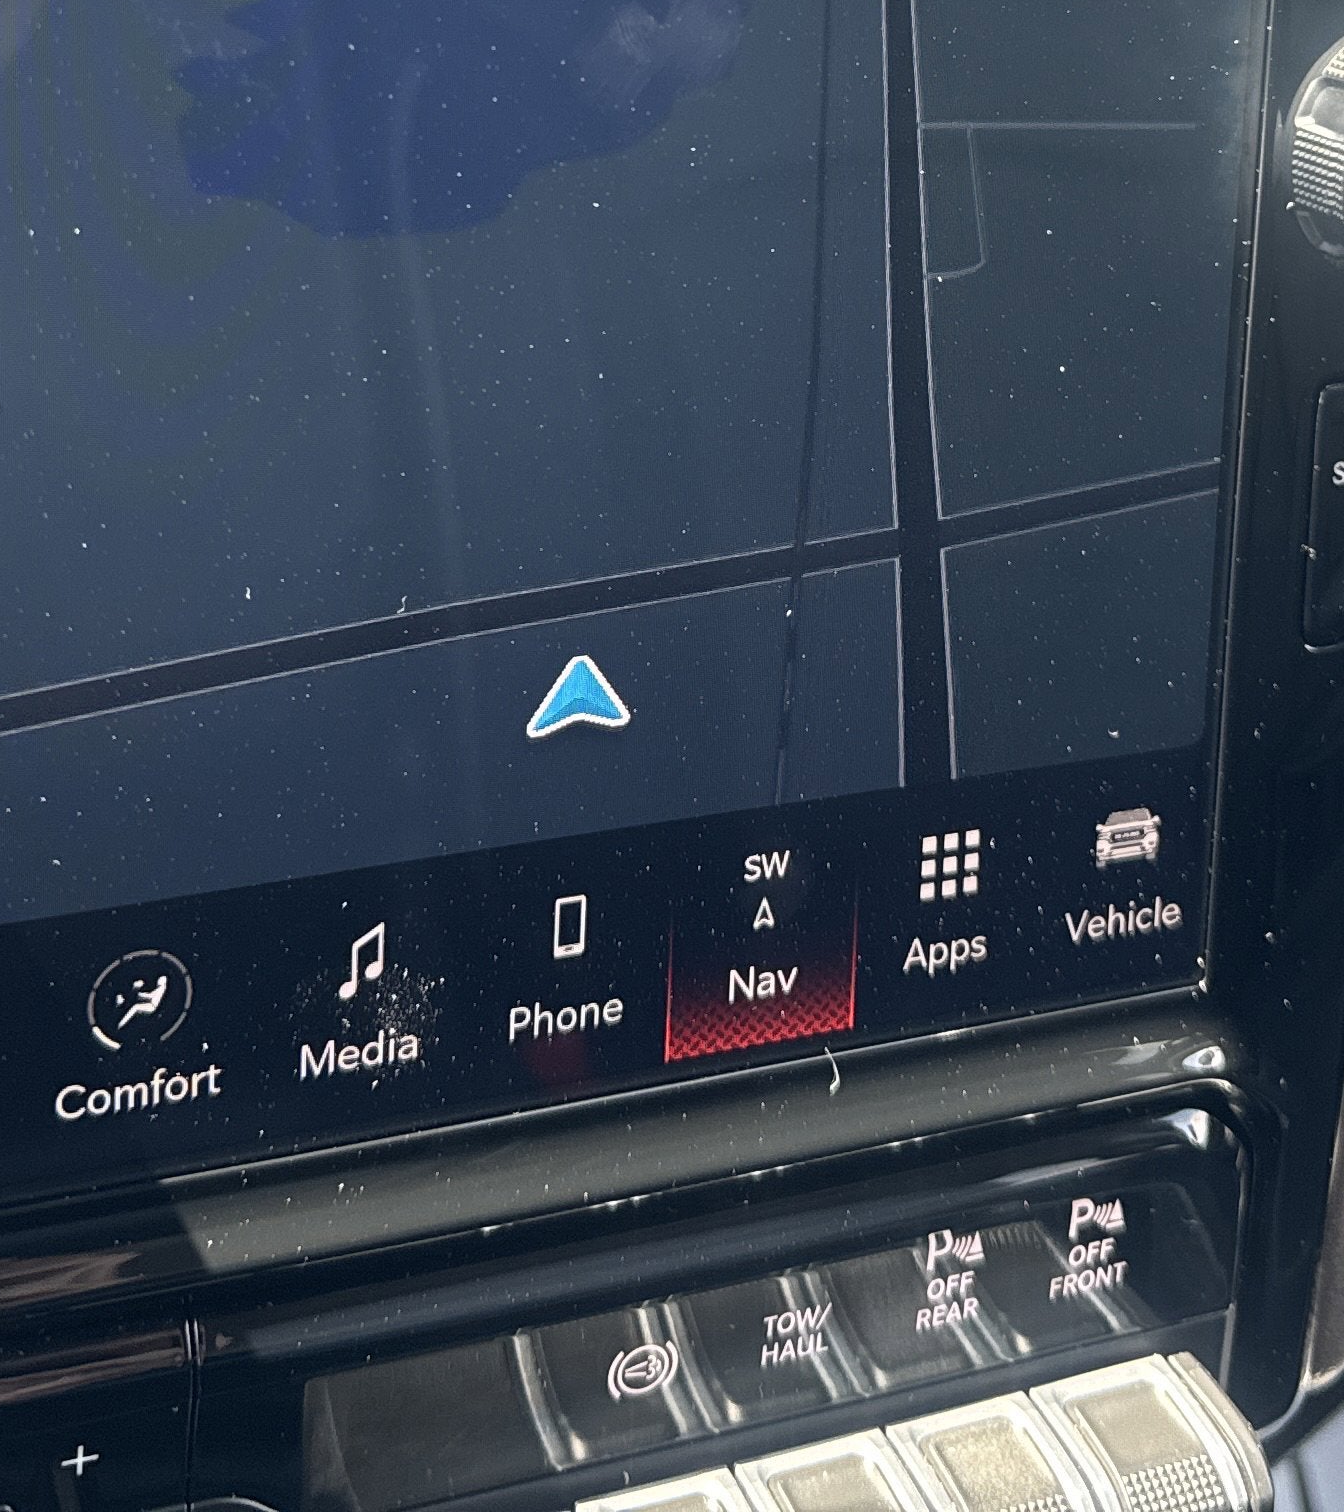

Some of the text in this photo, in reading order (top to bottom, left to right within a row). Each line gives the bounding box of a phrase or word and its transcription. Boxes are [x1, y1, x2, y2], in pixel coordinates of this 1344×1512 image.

[742, 850, 790, 883] SW
[1064, 896, 1182, 945] Vehicle
[902, 932, 988, 976] Apps
[728, 965, 799, 1005] Nav
[508, 995, 625, 1043] Phone
[299, 1027, 420, 1081] Media
[55, 1064, 221, 1122] Comfort
[1068, 1236, 1117, 1268] OFF
[926, 1270, 976, 1304] OFF
[1049, 1260, 1128, 1300] FRONT
[762, 1302, 832, 1339] TOW/
[916, 1297, 980, 1333] REAR
[760, 1332, 829, 1366] HAUL
